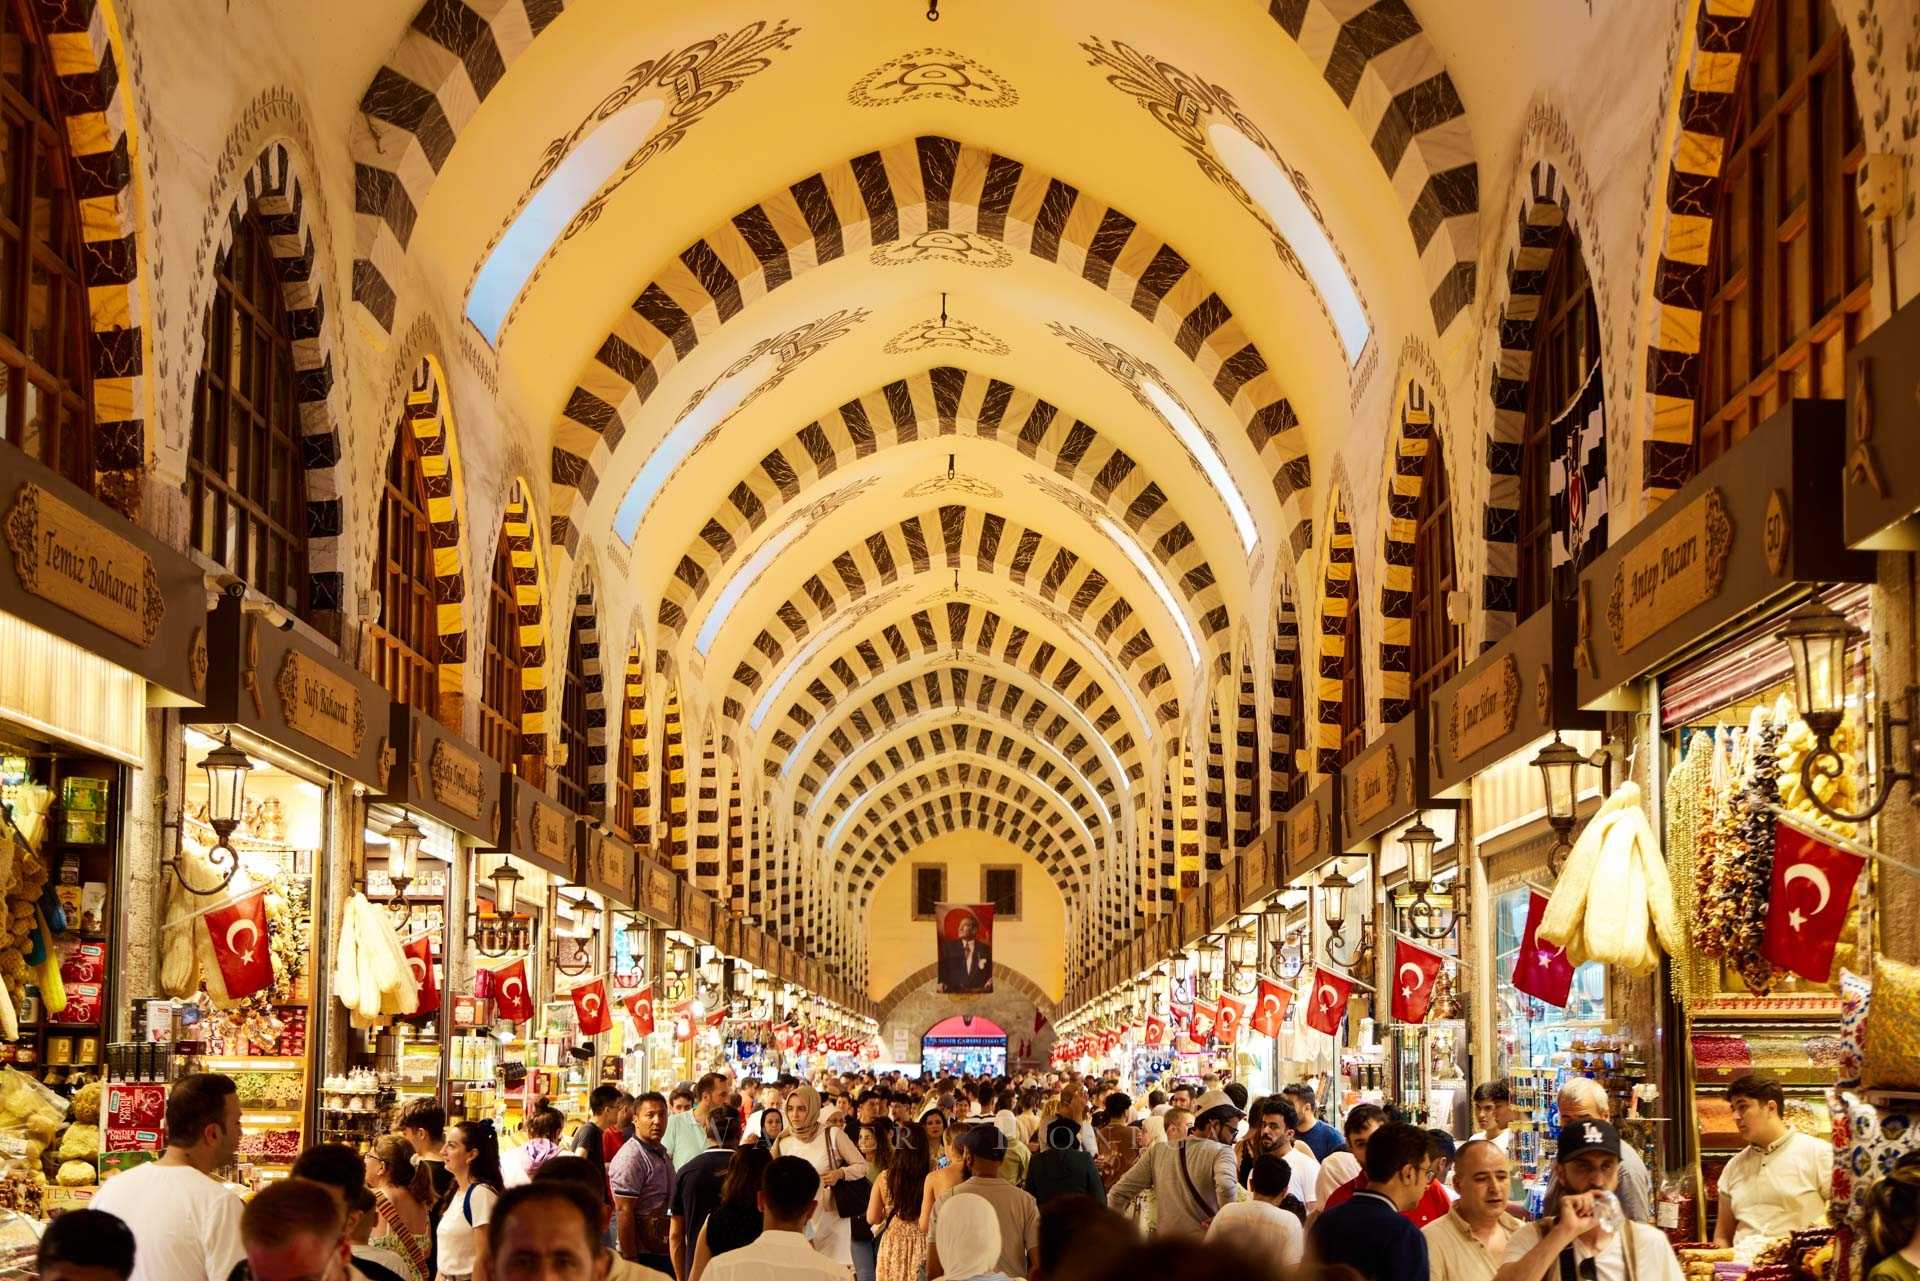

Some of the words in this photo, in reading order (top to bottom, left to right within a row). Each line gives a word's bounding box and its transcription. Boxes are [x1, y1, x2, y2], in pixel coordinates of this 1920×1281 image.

[1767, 513, 1781, 552] 50
[43, 528, 85, 584] Temiz
[88, 555, 138, 613] Baharat
[1629, 563, 1660, 607] Antep
[1582, 1122, 1603, 1144] LA
[45, 1187, 72, 1200] TEA
